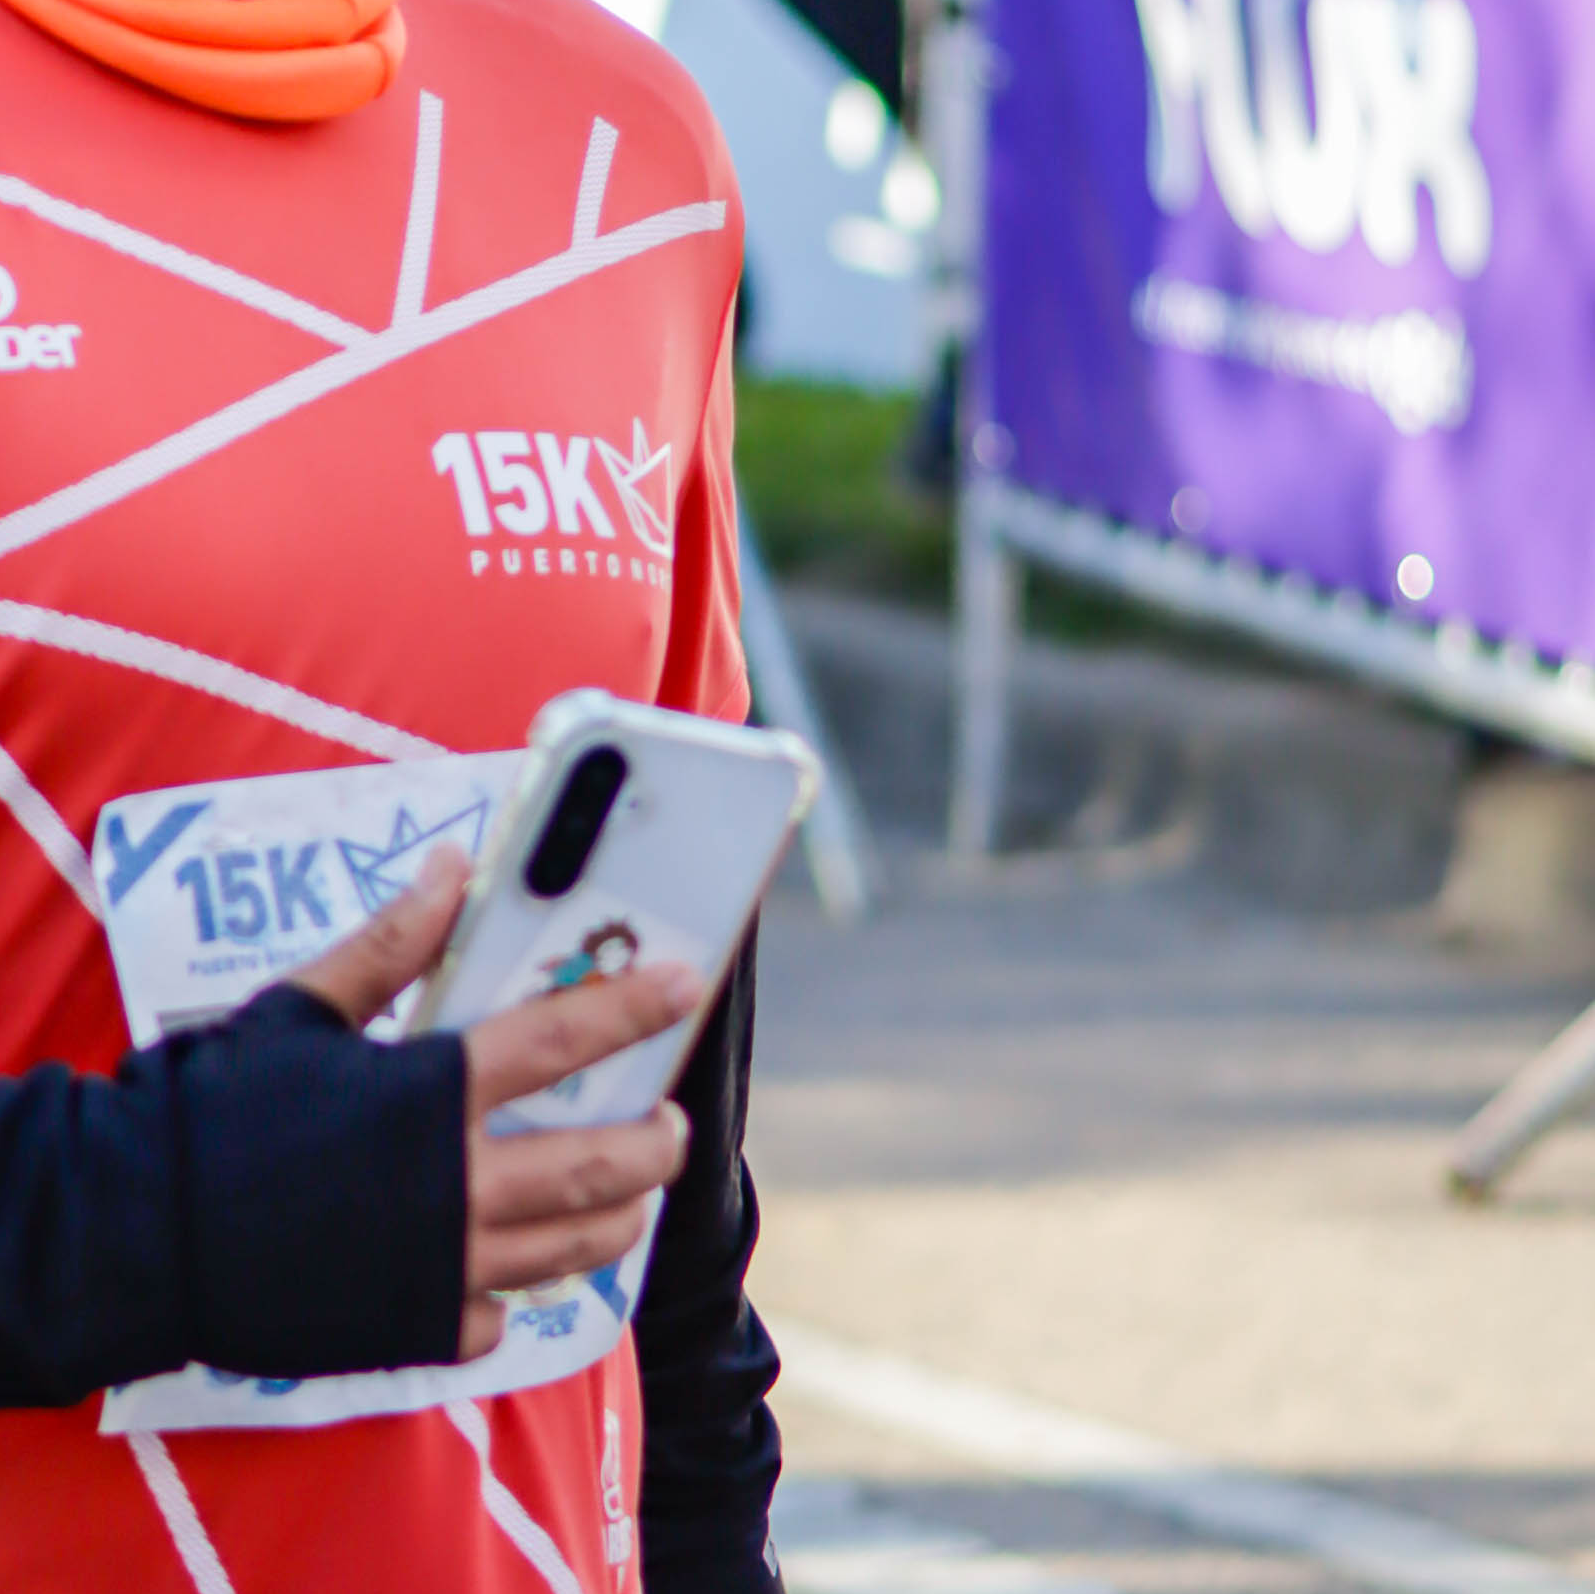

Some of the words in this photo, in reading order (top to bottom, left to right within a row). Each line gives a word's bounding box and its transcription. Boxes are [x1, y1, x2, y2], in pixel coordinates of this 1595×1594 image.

[430, 431, 617, 540] 15K
[469, 548, 621, 579] PUERTO
[175, 842, 330, 943] 15K
